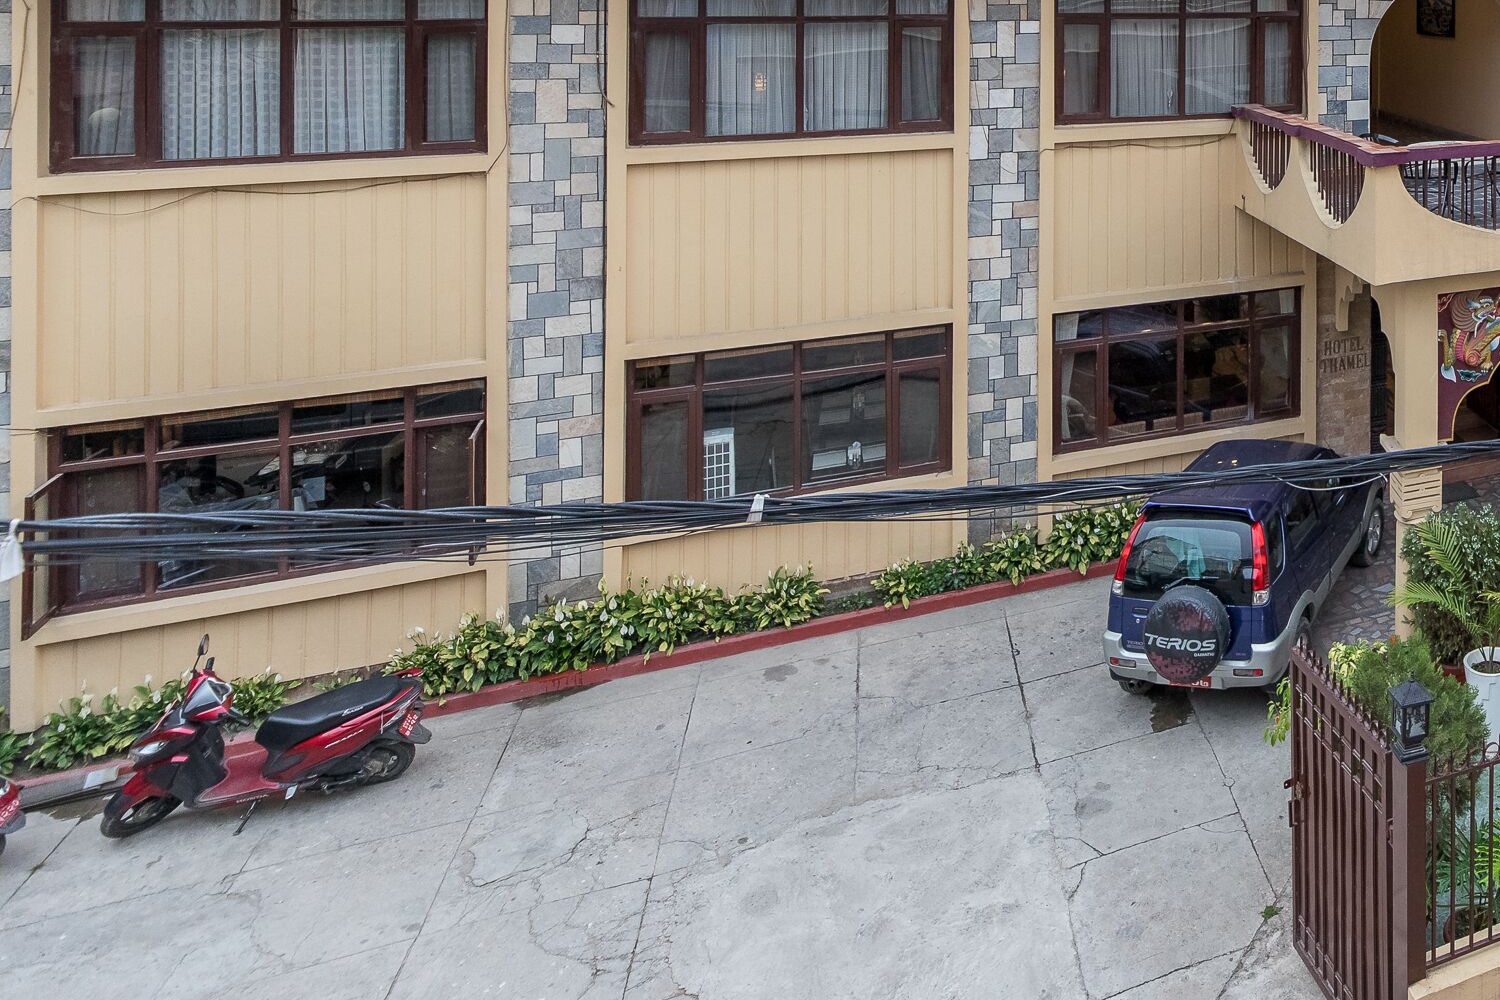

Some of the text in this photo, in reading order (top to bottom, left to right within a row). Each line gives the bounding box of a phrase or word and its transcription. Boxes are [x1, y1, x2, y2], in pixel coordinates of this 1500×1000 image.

[1323, 336, 1364, 356] HOTEL
[1319, 353, 1370, 373] THAMEL
[1144, 633, 1217, 652] TERIOS
